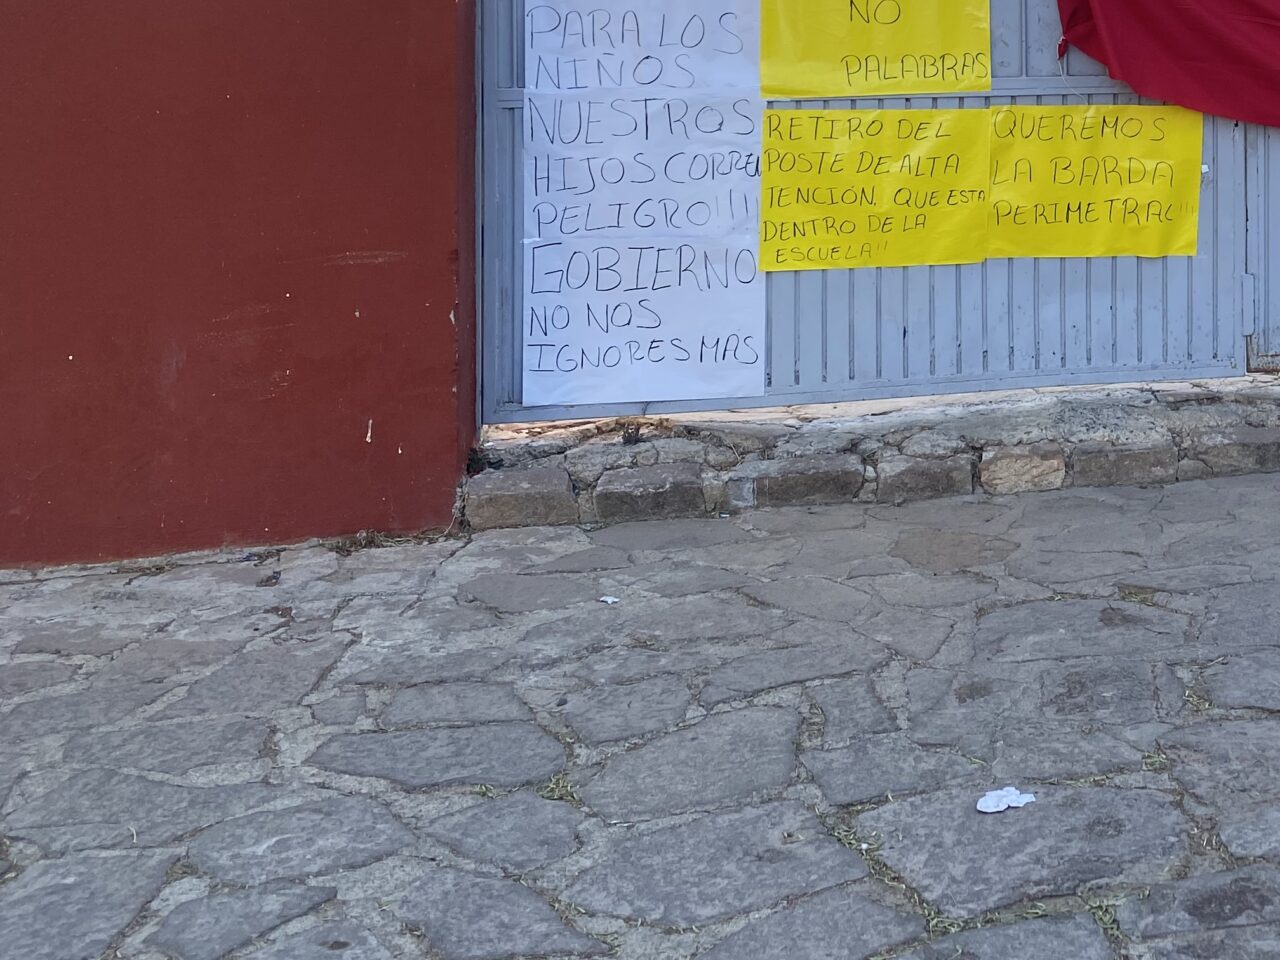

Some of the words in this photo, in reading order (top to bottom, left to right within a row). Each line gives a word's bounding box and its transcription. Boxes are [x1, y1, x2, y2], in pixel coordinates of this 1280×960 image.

[526, 5, 642, 49] PARA
[659, 11, 744, 55] LOS
[535, 52, 696, 90] NIÑOS
[841, 52, 989, 87] PALABRAS
[528, 96, 755, 145] NUESTROS
[767, 113, 884, 141] RETIRO
[897, 118, 951, 141] DEL
[994, 109, 1167, 141] QUEREMOS
[533, 151, 656, 197] HIJOS
[764, 147, 845, 175] POSTE
[856, 150, 892, 175] DE
[900, 153, 960, 178] ALTA
[992, 158, 1032, 186] LA
[1050, 155, 1174, 188] BARDA
[893, 186, 940, 209] QUE
[946, 189, 986, 206] ESTA
[762, 216, 856, 242] DENTRO
[868, 214, 895, 233] DE
[902, 213, 927, 232] LA
[531, 242, 757, 294] GOBIERNO
[529, 304, 570, 337] NO
[586, 298, 662, 334] NOS
[527, 338, 691, 373] IGNORES
[699, 333, 759, 365] MAS
